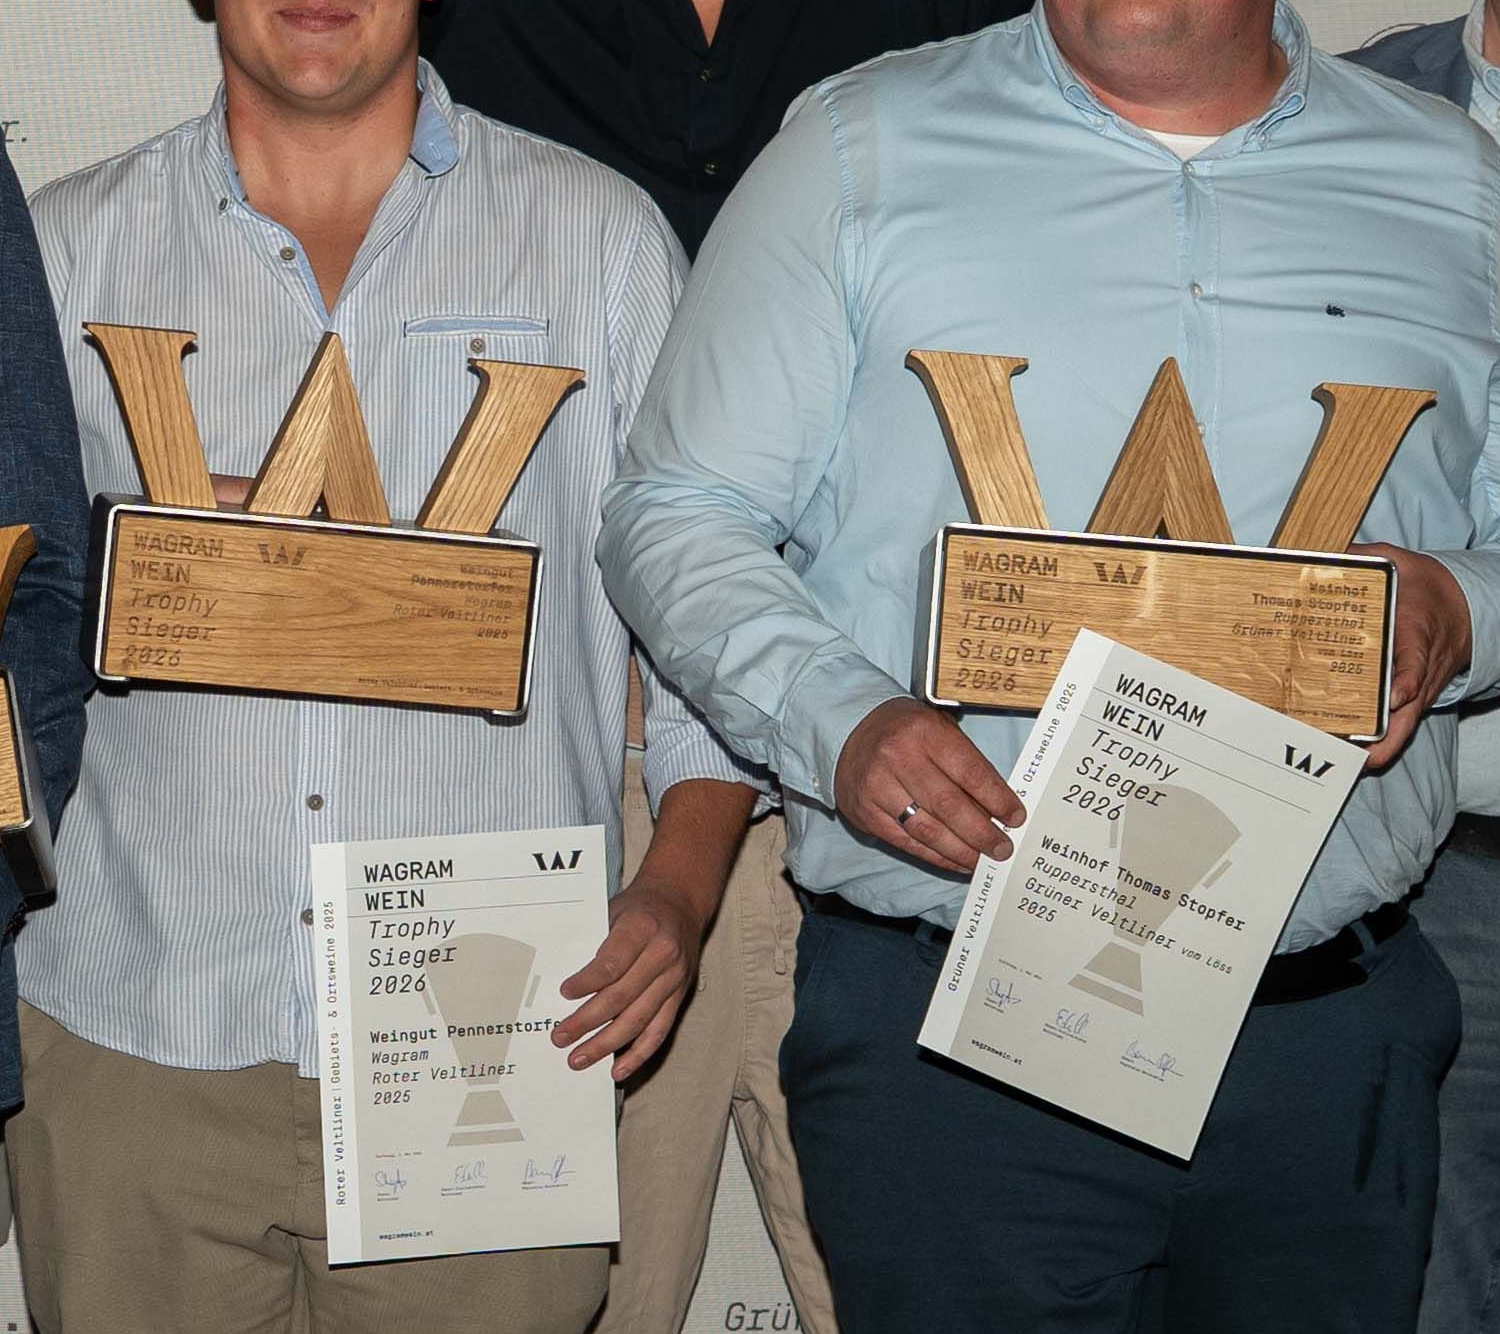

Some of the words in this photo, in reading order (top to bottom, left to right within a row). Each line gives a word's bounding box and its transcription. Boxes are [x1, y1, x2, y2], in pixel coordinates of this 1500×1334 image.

[131, 530, 225, 560] WAGRAM
[130, 558, 192, 586] WEIN
[961, 550, 1059, 578] WAGRAM
[128, 588, 219, 618] Trophy
[960, 579, 1026, 605] WEIN
[1308, 598, 1368, 614] Stopfer
[126, 615, 218, 644] Sieger
[960, 609, 1055, 638] Trophy
[121, 644, 182, 669] 2026
[955, 638, 1055, 666] Sieger
[954, 668, 1018, 693] 2026
[1115, 673, 1208, 728] WAGRAM
[1023, 716, 1061, 784] Ortsweine
[1056, 682, 1077, 713] 2025
[1102, 700, 1166, 742] WEIN
[1089, 728, 1180, 782] Trophy
[1075, 756, 1168, 808] Sieger
[1061, 783, 1126, 822] 2026
[364, 859, 454, 884] WAGRAM
[1031, 856, 1137, 909] Ruppersthal
[1041, 834, 1110, 874] Weinhof
[1116, 866, 1171, 902] Thomas
[1177, 893, 1247, 932] Stopfer
[323, 900, 334, 930] 2025
[364, 889, 426, 912] WEIN
[1016, 897, 1057, 923] 2025
[369, 916, 456, 940] Trophy
[948, 946, 970, 992] Grüner
[965, 873, 995, 941] Veltliner
[1024, 876, 1083, 911] Grüner
[1089, 905, 1177, 950] Veltliner
[1180, 946, 1203, 962] vom
[1205, 955, 1233, 975] Löss
[326, 938, 338, 1004] Ortsweine
[368, 946, 459, 972] Sieger
[369, 973, 428, 996] 2026
[370, 1028, 438, 1045] Weingut
[371, 1049, 430, 1066] Wagram
[372, 1070, 421, 1085] Roter
[430, 1063, 518, 1081] Veltliner
[373, 1089, 412, 1105] 2025
[328, 1094, 344, 1164] Veltliner
[336, 1168, 347, 1206] Roter
